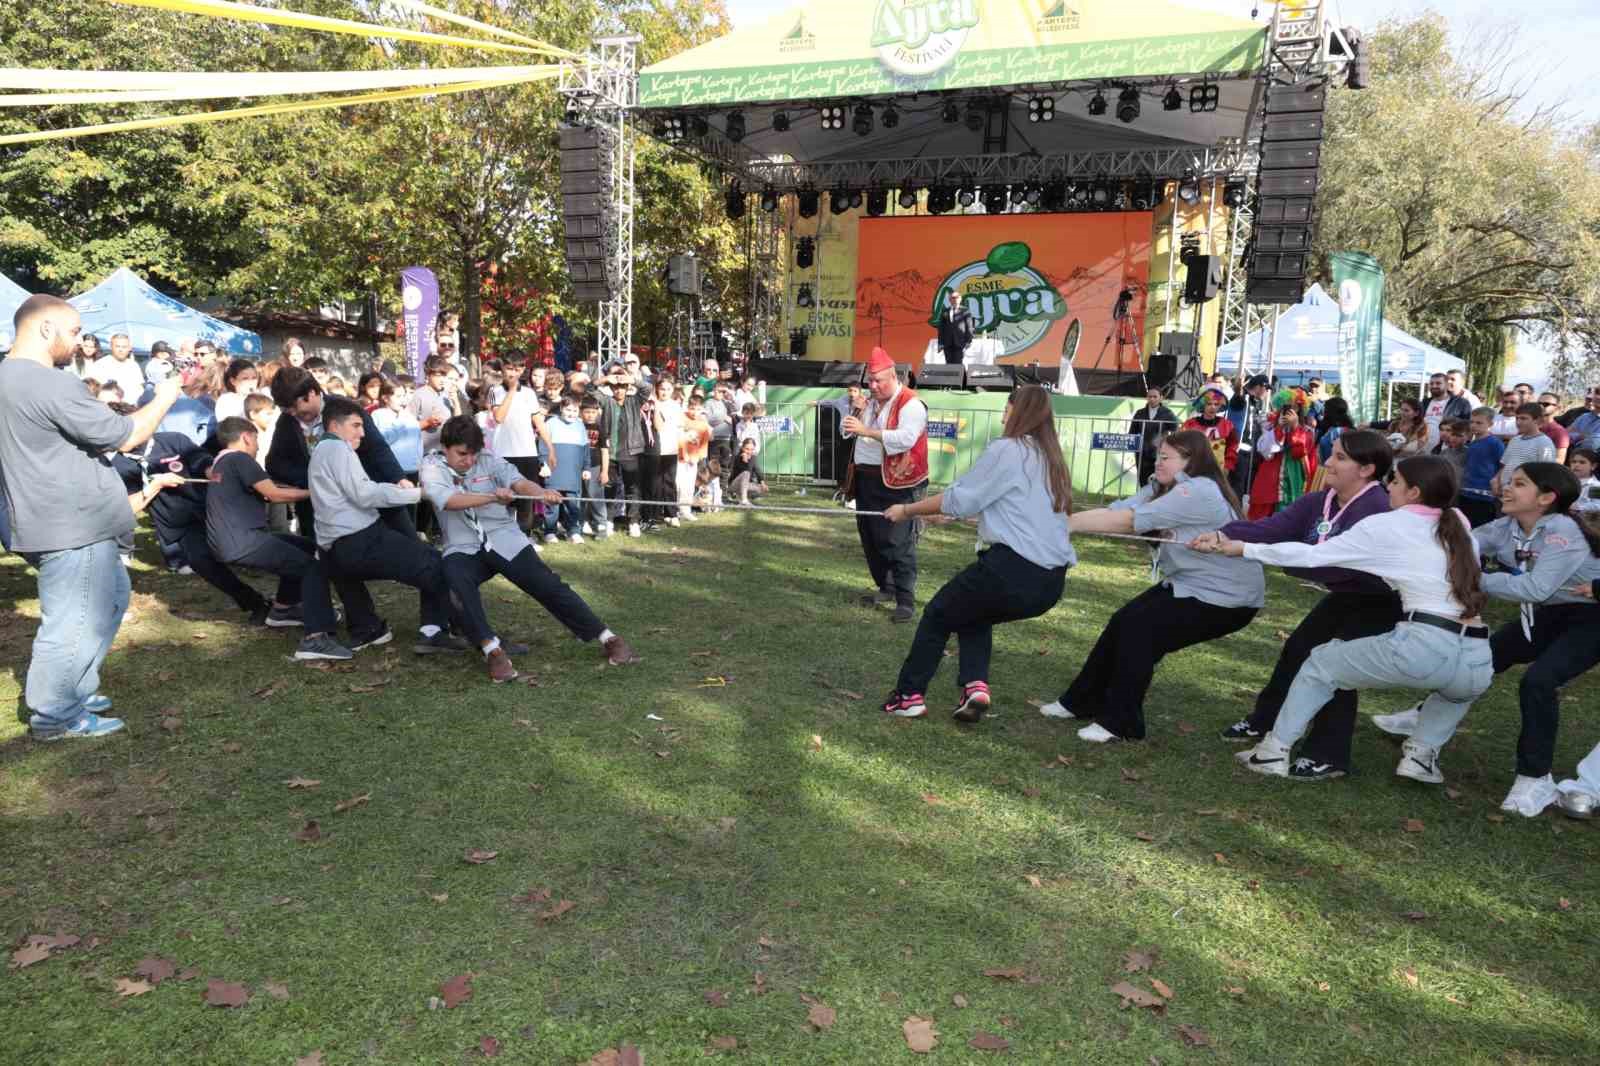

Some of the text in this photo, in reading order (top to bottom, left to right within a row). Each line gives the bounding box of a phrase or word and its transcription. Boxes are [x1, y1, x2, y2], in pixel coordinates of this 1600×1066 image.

[1006, 49, 1069, 69] Kartepe
[1133, 41, 1199, 60] Kartepe
[651, 75, 702, 92] Kartepe
[748, 72, 790, 87] Kartepe
[791, 65, 846, 85] Kartepe
[944, 71, 1004, 88] Kartepe
[1062, 61, 1128, 79] Kartepe
[681, 88, 735, 105] Kartepe
[735, 84, 786, 102] Kartepe
[789, 82, 831, 99] Kartepe
[836, 77, 889, 94] Kartepe
